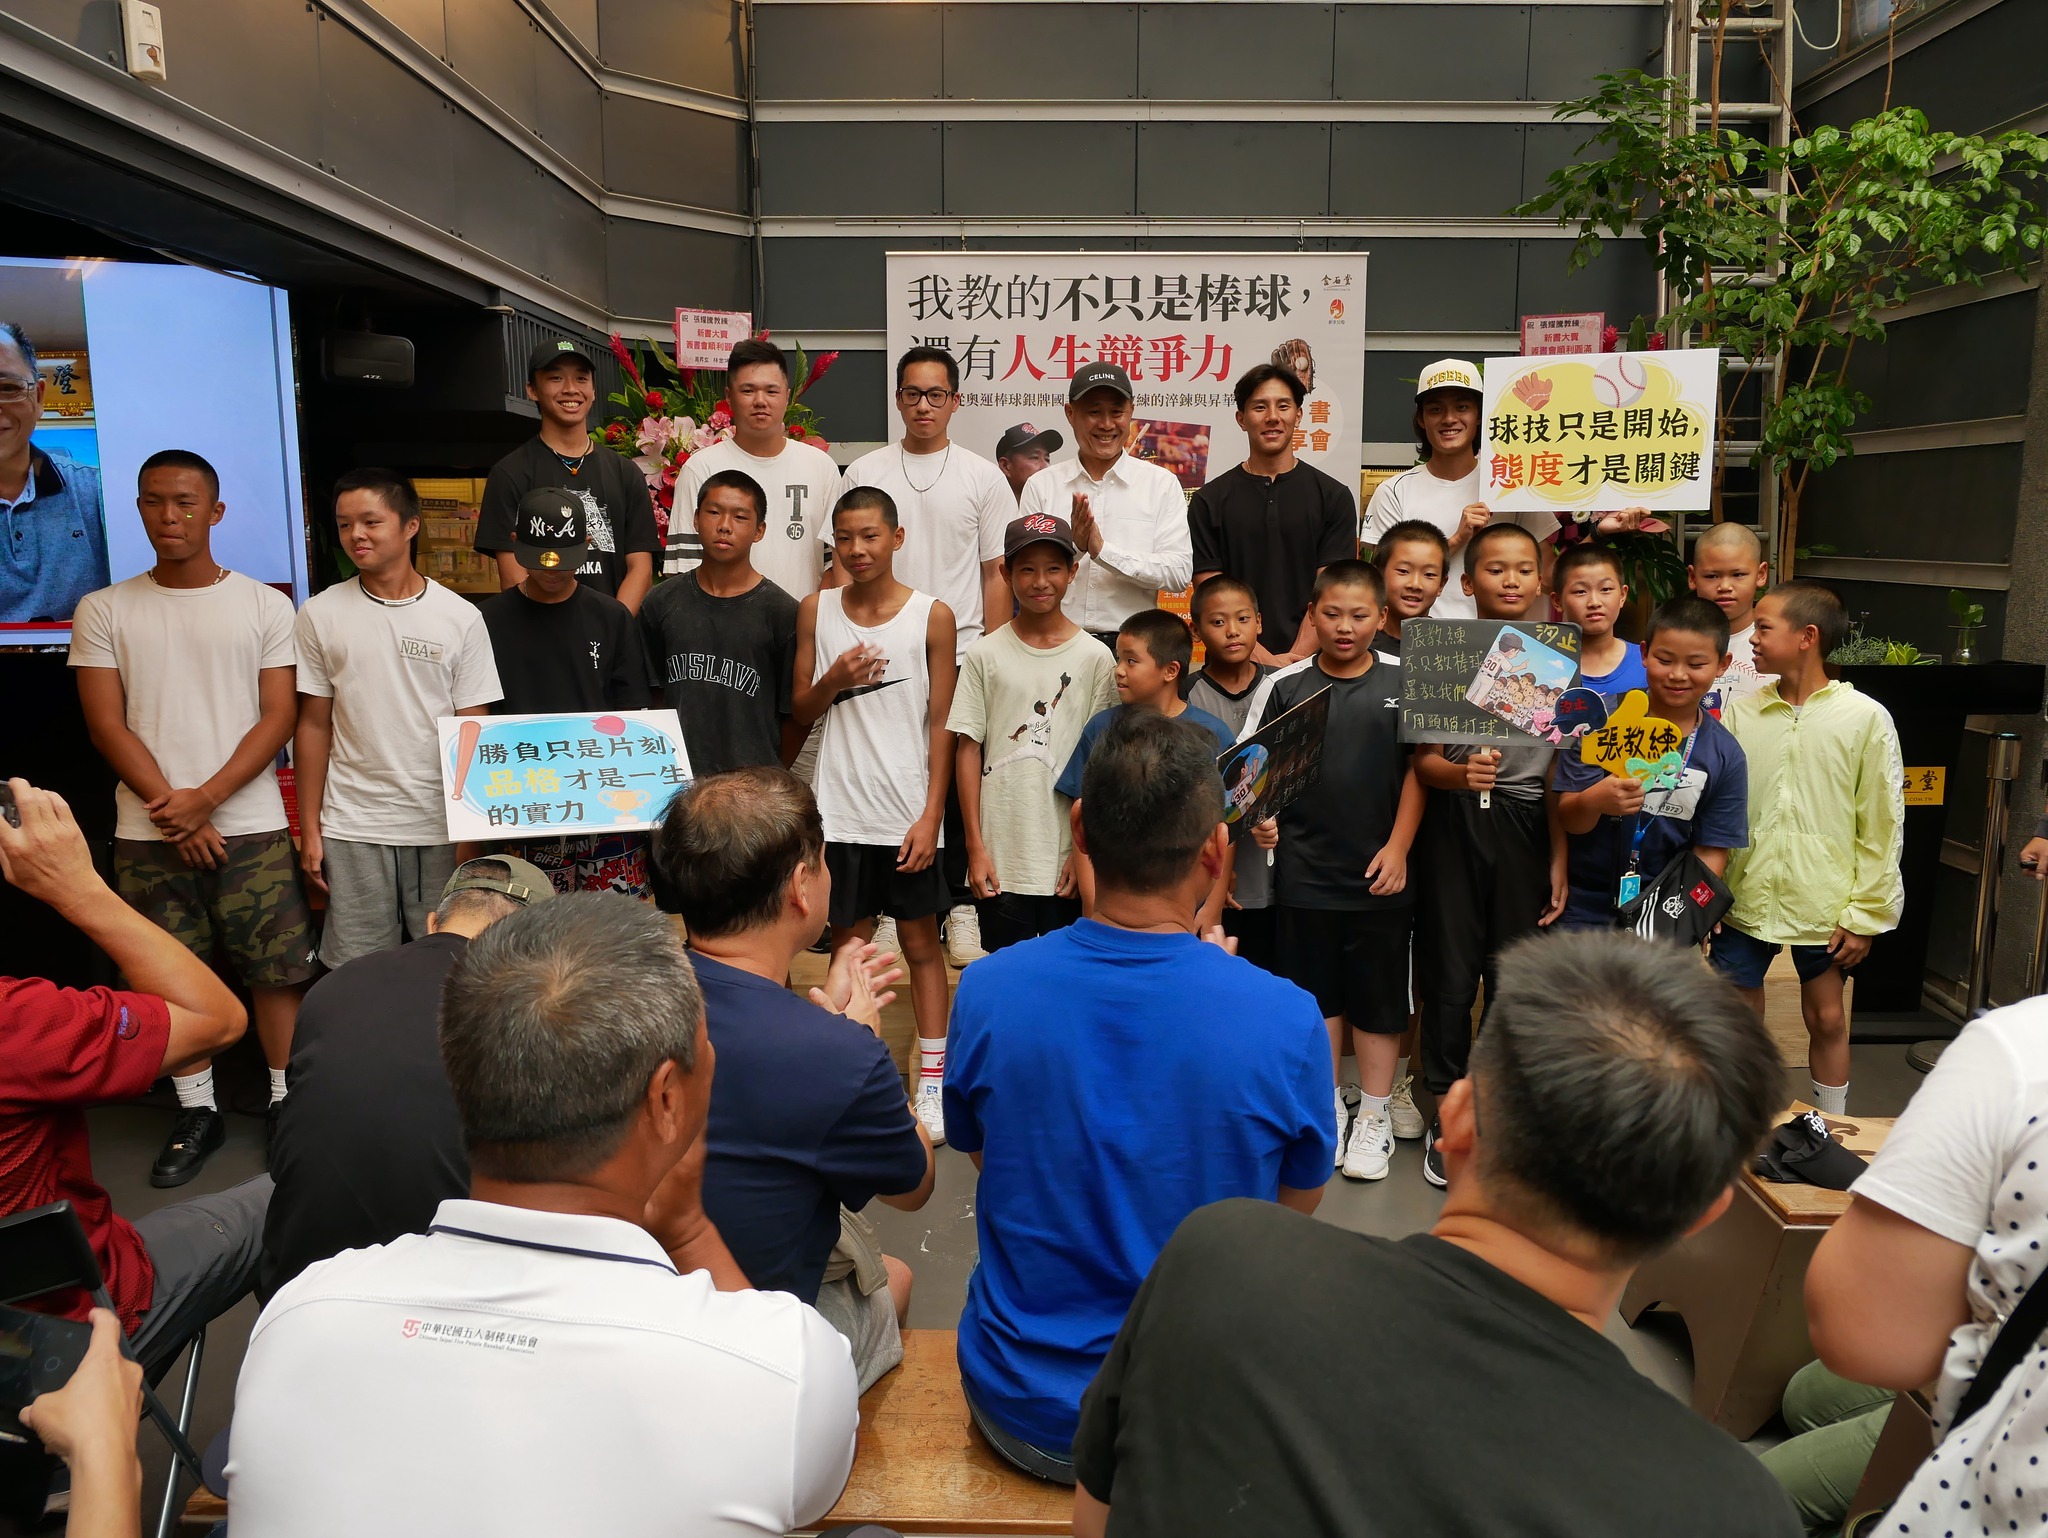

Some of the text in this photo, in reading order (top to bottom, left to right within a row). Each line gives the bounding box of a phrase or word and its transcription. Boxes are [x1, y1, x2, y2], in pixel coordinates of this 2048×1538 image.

[1321, 274, 1352, 286] 金石堂
[697, 328, 729, 339] 新書大賣
[1544, 332, 1579, 342] 新書大賣
[1088, 372, 1116, 382] CELINE
[1426, 368, 1472, 389] TIGERS
[1309, 400, 1331, 424] 書
[1488, 451, 1701, 489] 態度才是關鍵
[785, 485, 808, 521] T
[530, 516, 546, 537] NY
[790, 525, 802, 538] 36
[1406, 623, 1467, 650] 張教練
[1535, 623, 1578, 653] 汐止
[400, 639, 428, 658] NBA
[1485, 659, 1498, 672] 30
[1596, 724, 1678, 763] 張教練
[484, 764, 687, 797] 品格才是一生
[487, 799, 584, 827] 的實力
[421, 1321, 538, 1348] 中華民國五人制棒球協會
